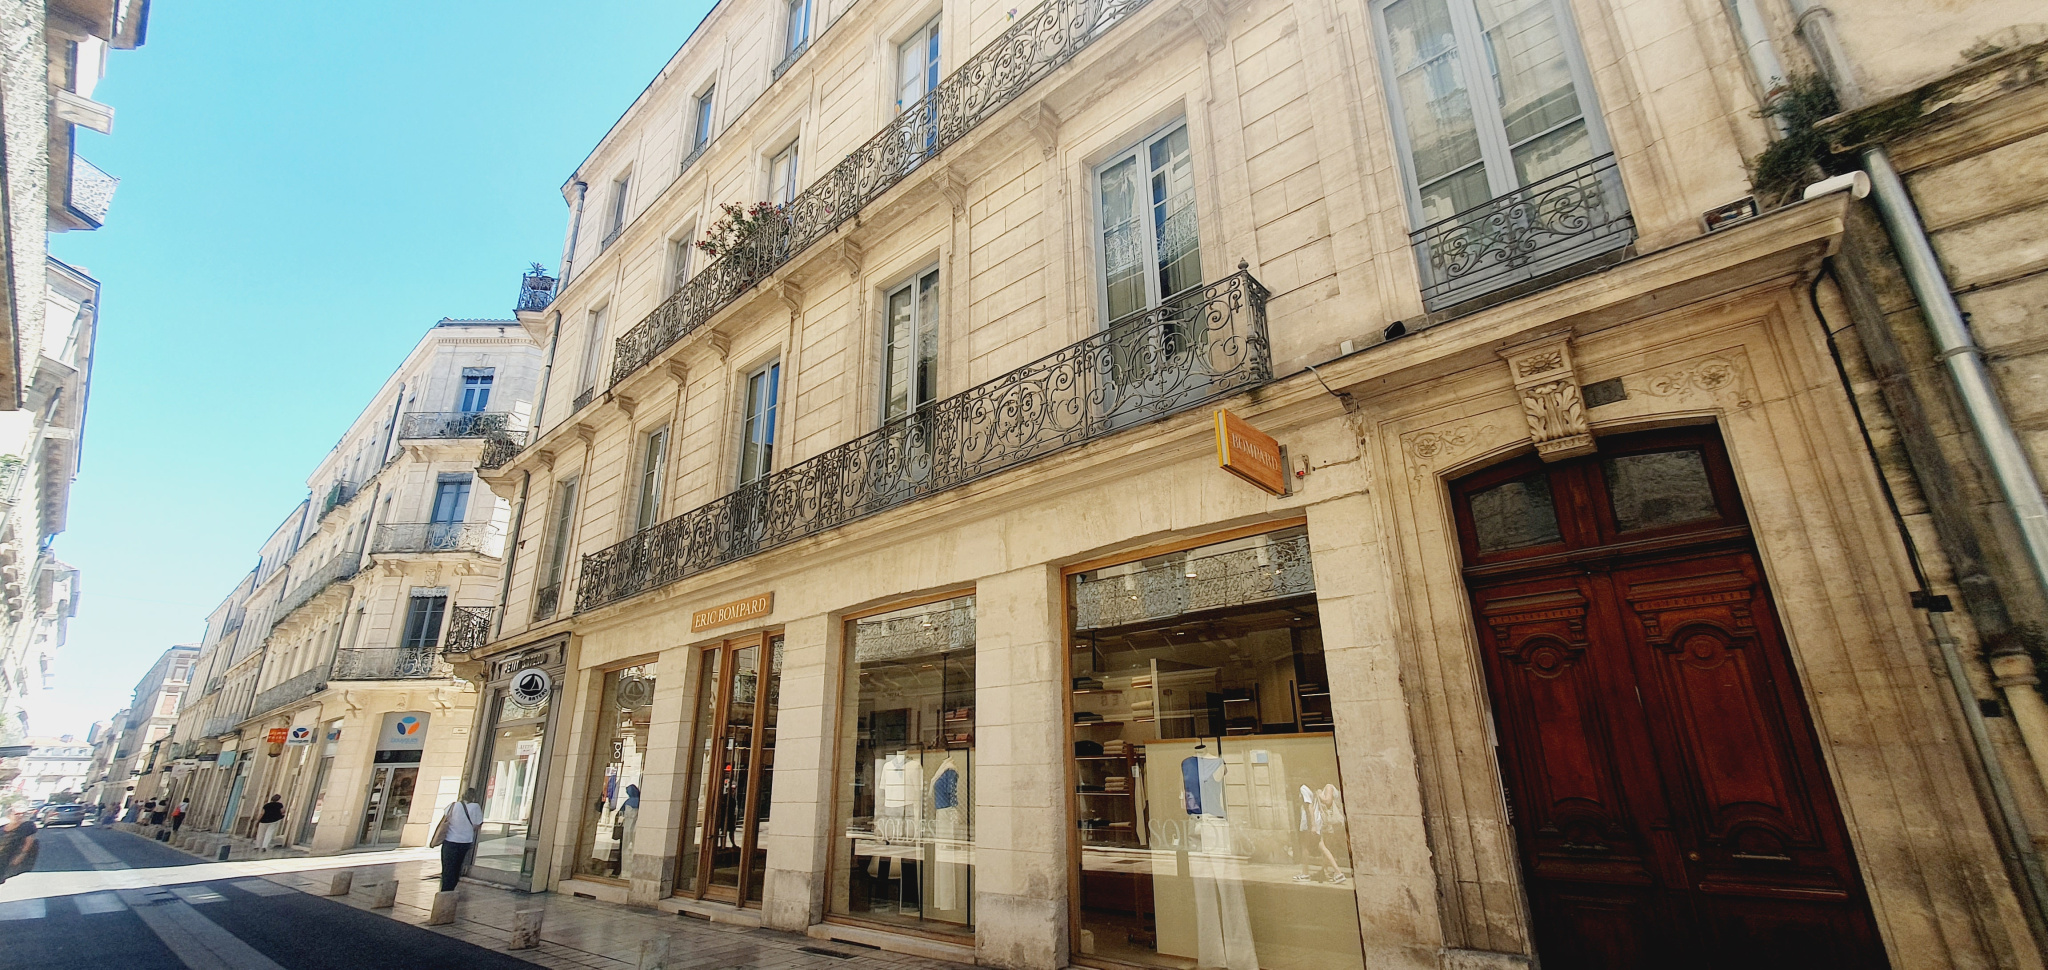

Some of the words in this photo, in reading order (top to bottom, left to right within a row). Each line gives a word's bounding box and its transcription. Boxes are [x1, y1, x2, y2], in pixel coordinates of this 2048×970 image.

[1231, 433, 1279, 470] BOMPARD
[694, 610, 717, 628] ERIC
[717, 597, 767, 623] BOMPARD
[514, 688, 527, 700] PETIT
[528, 688, 548, 702] BATEAU
[1148, 818, 1256, 856] SOLDS
